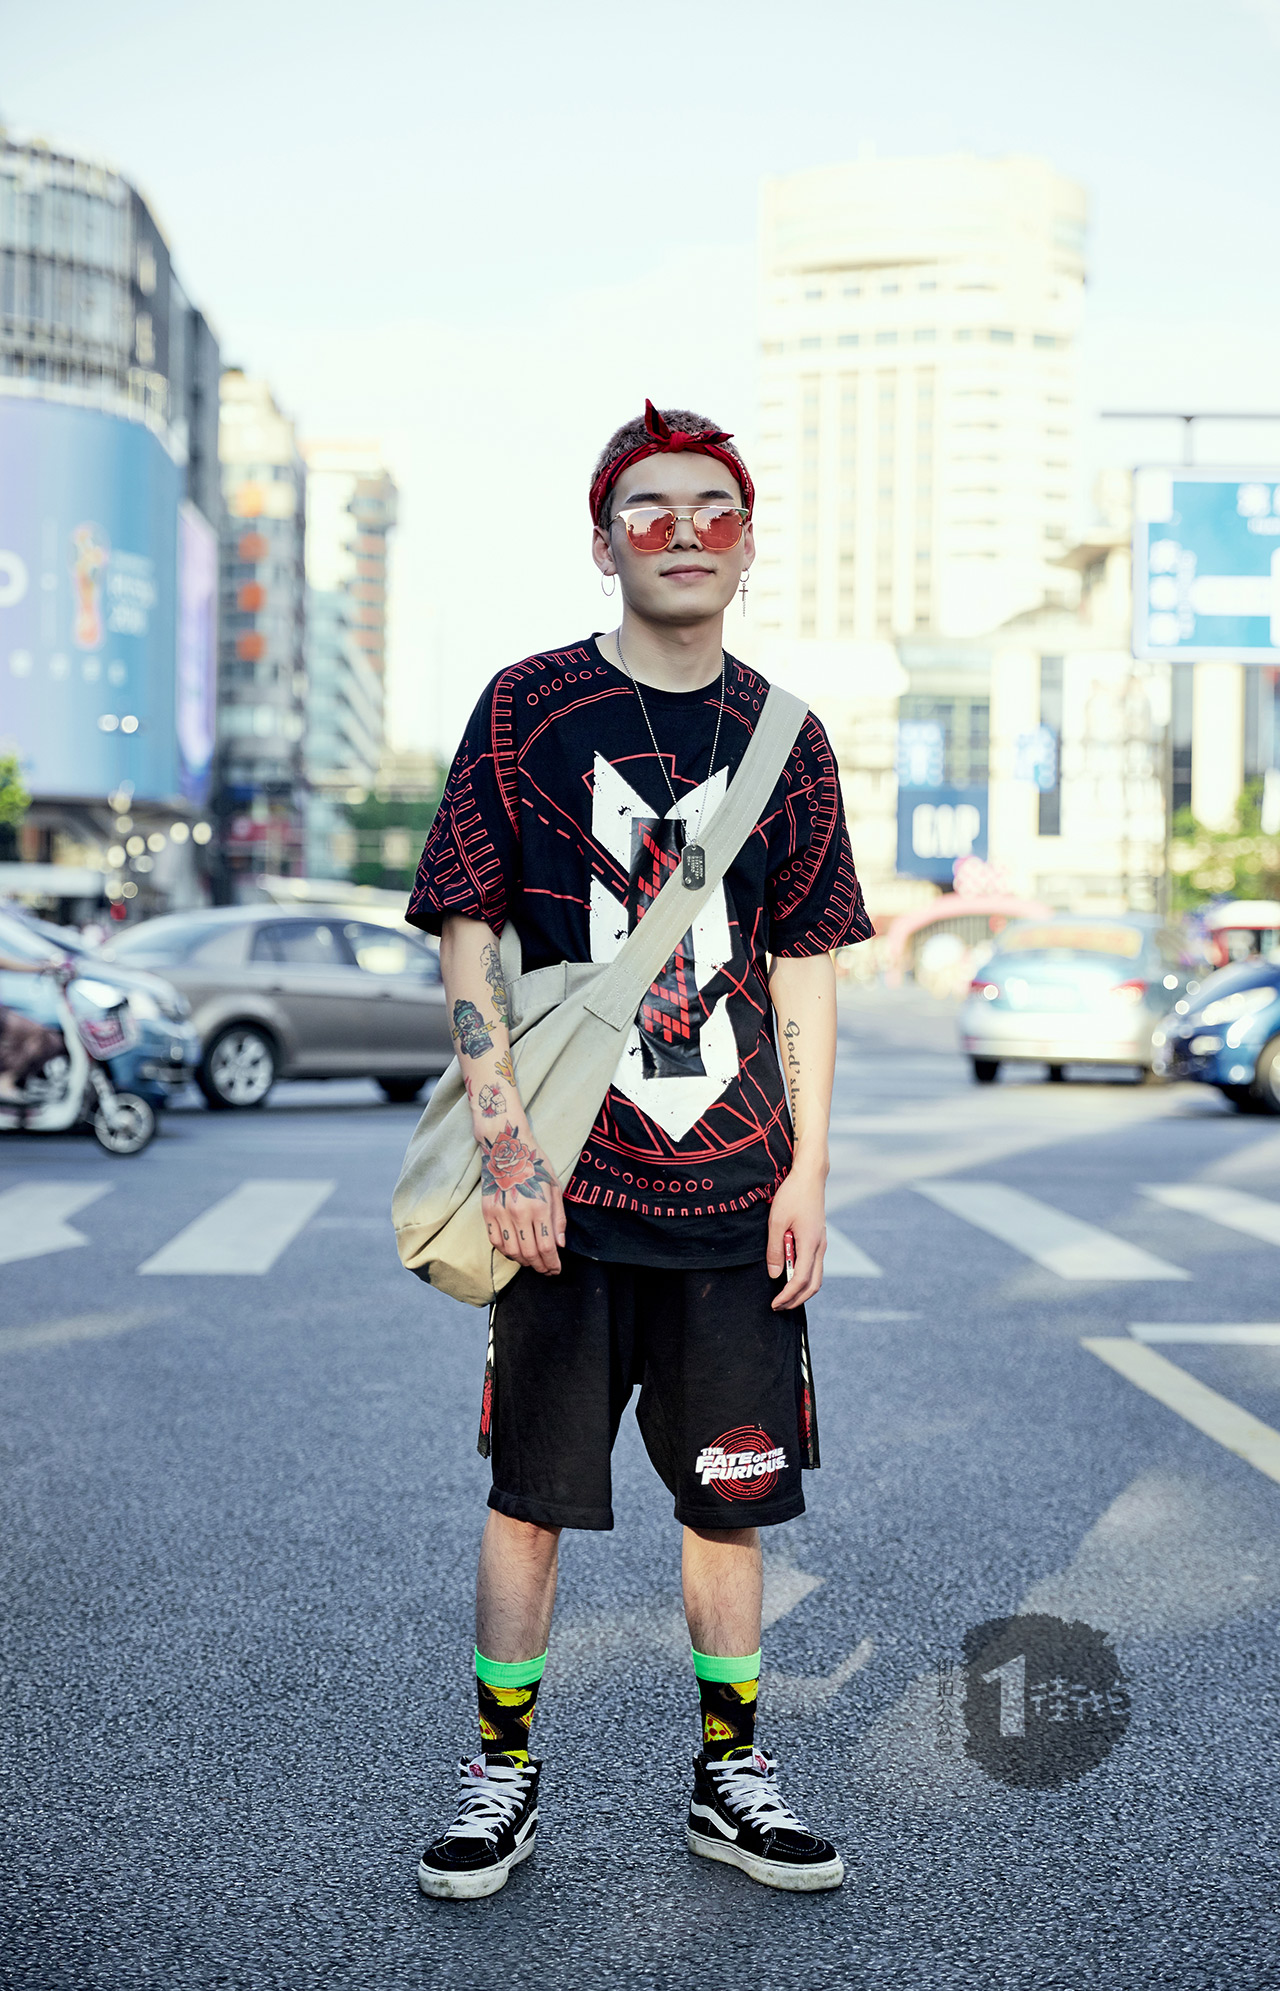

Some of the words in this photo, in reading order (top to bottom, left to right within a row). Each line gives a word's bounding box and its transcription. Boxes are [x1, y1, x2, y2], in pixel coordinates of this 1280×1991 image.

[695, 1451, 754, 1473] FATE
[752, 1453, 766, 1463] OF
[767, 1447, 784, 1459] THE
[700, 1447, 724, 1456] THE
